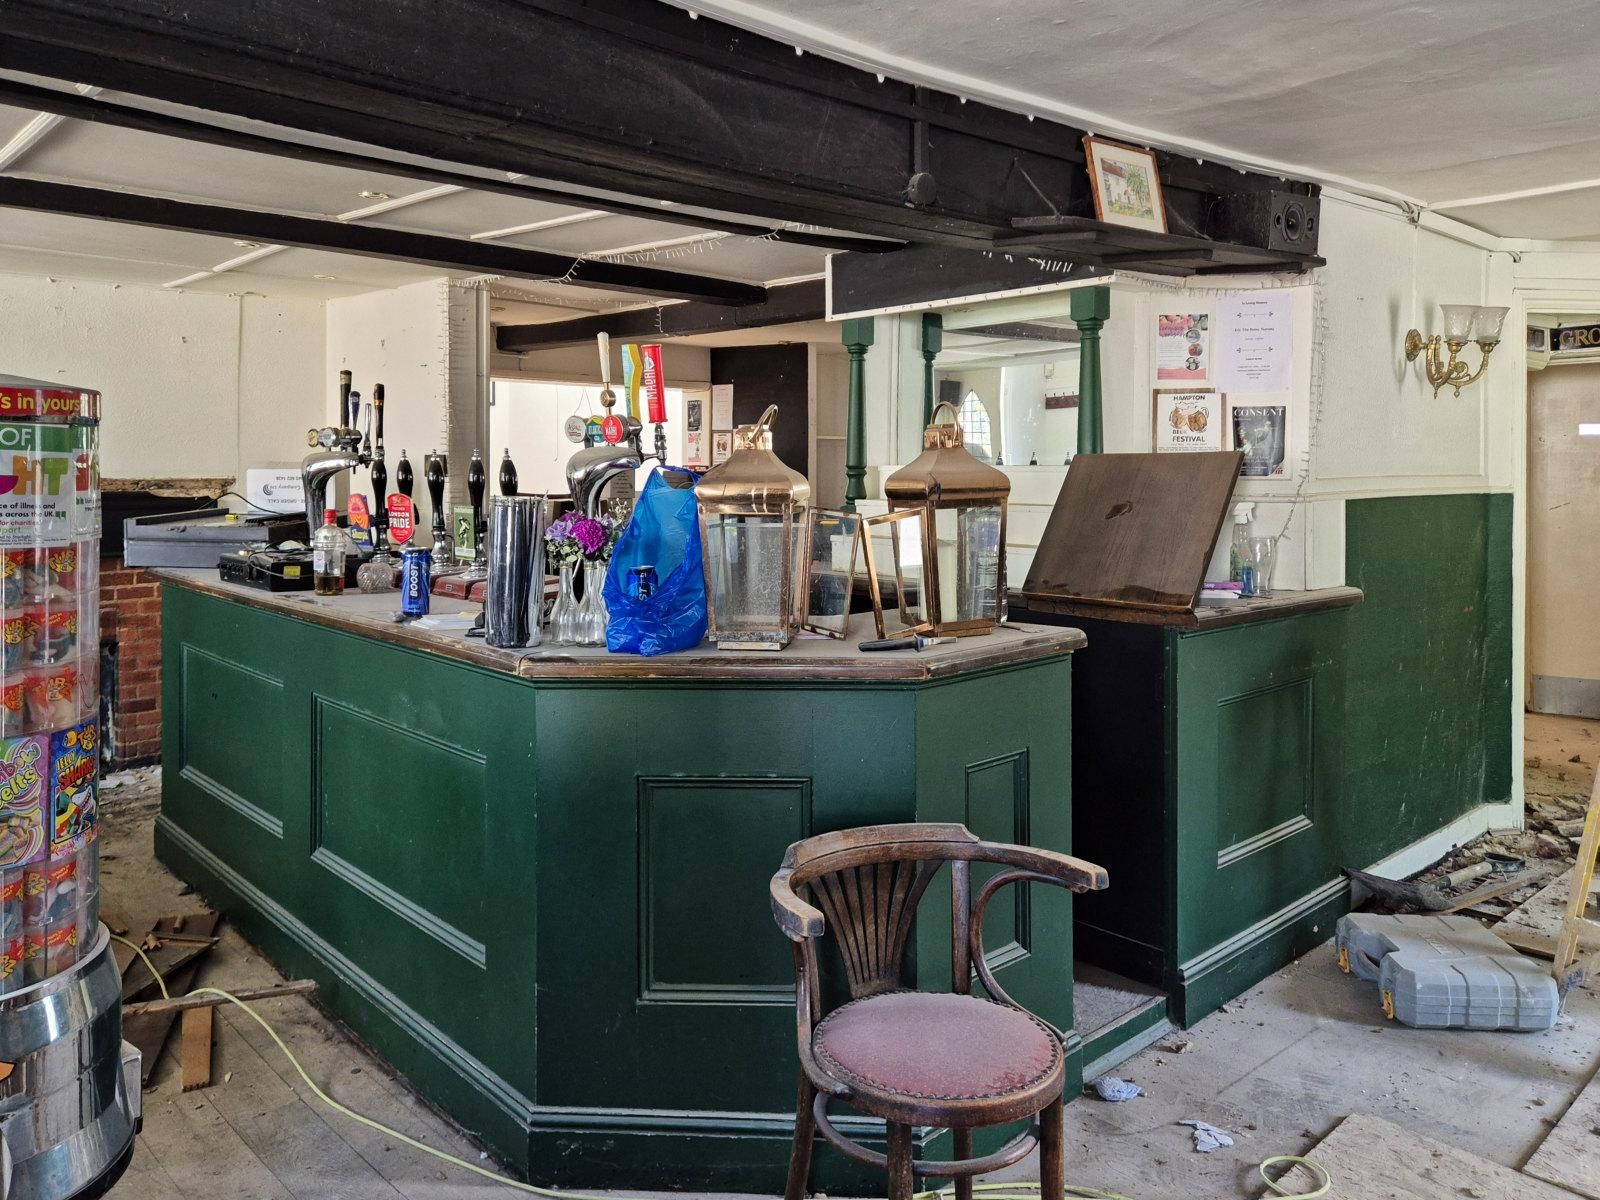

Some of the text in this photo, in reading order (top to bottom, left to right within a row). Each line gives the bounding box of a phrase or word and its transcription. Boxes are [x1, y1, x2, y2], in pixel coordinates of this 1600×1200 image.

[17, 393, 35, 410] in
[42, 397, 81, 415] yours
[1234, 408, 1283, 417] CONSENT
[0, 427, 32, 447] OF
[10, 502, 18, 510] of
[389, 518, 411, 528] PRIDE
[409, 563, 419, 598] BOOST
[0, 768, 39, 807] elts
